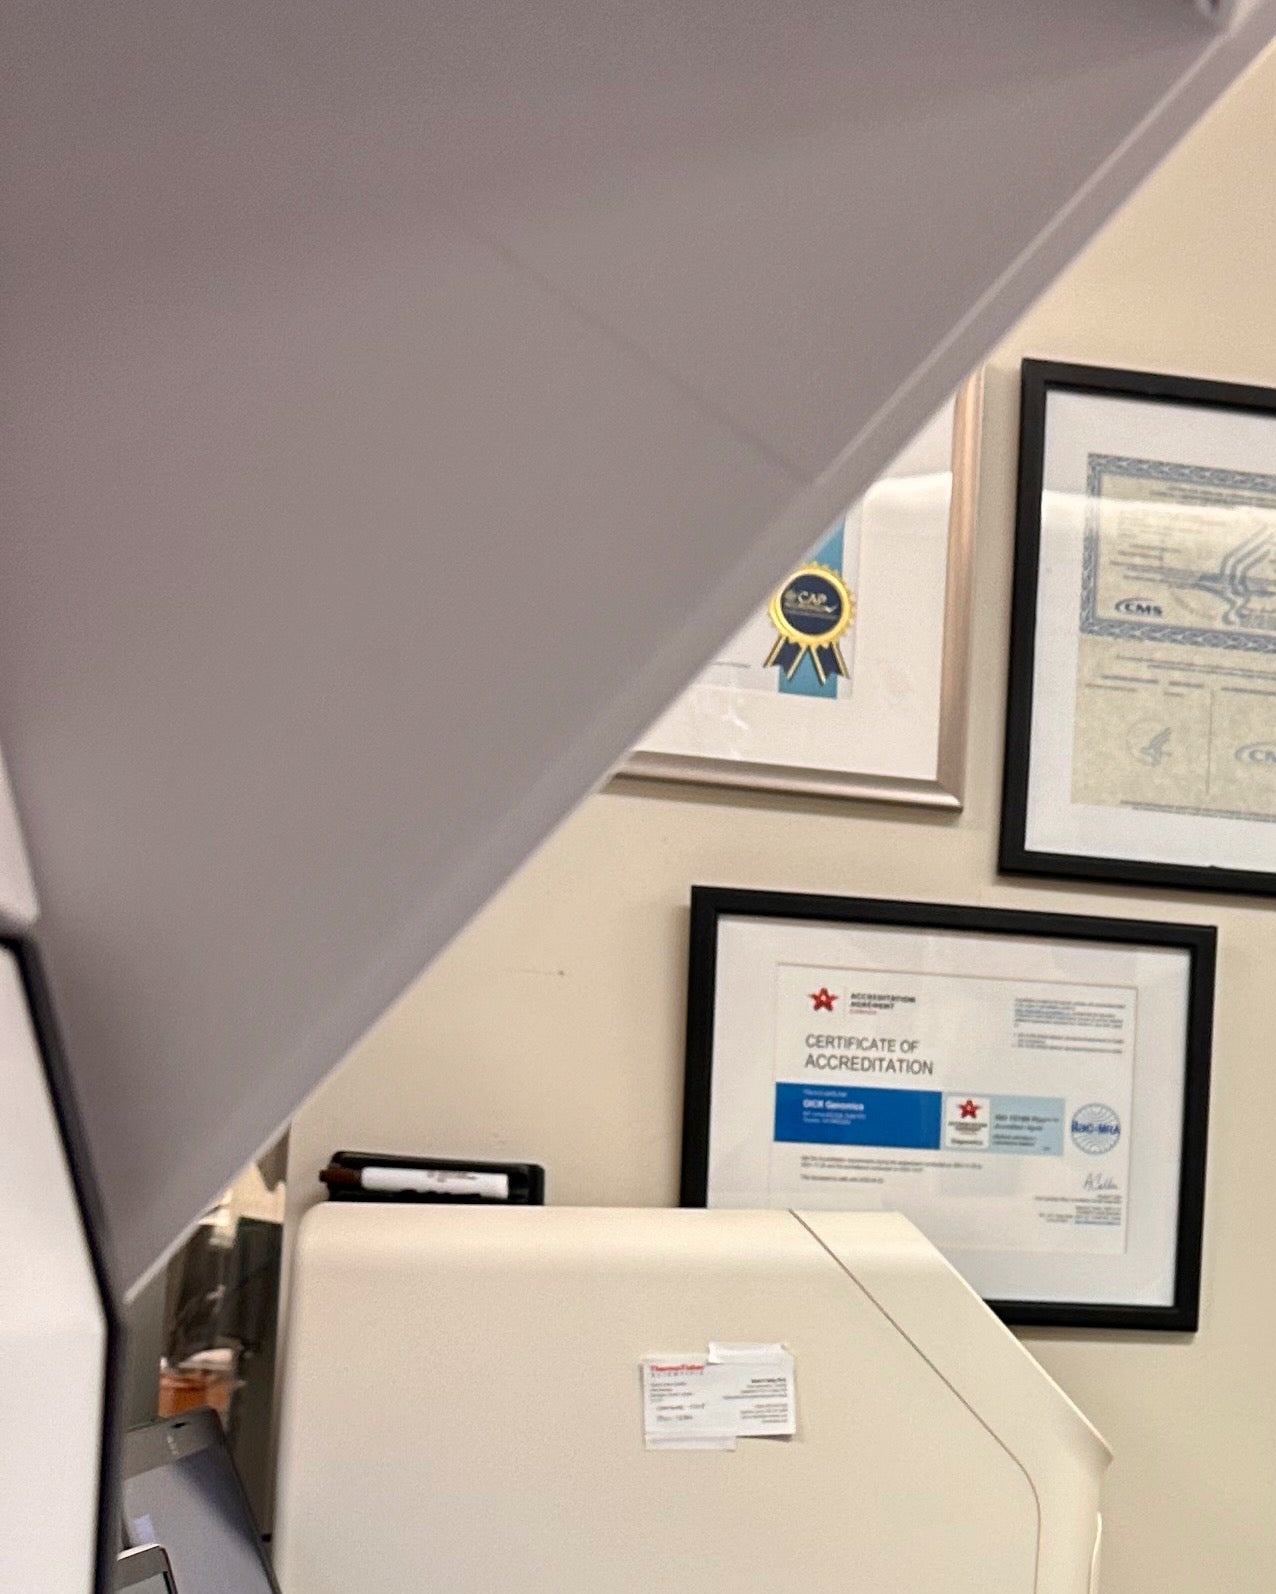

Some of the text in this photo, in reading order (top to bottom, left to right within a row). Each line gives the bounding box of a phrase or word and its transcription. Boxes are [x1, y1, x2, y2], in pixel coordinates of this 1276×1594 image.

[1124, 602, 1163, 617] CMS
[804, 1033, 920, 1054] CERTIFICATE OF
[803, 1053, 934, 1076] ACCREDITATION
